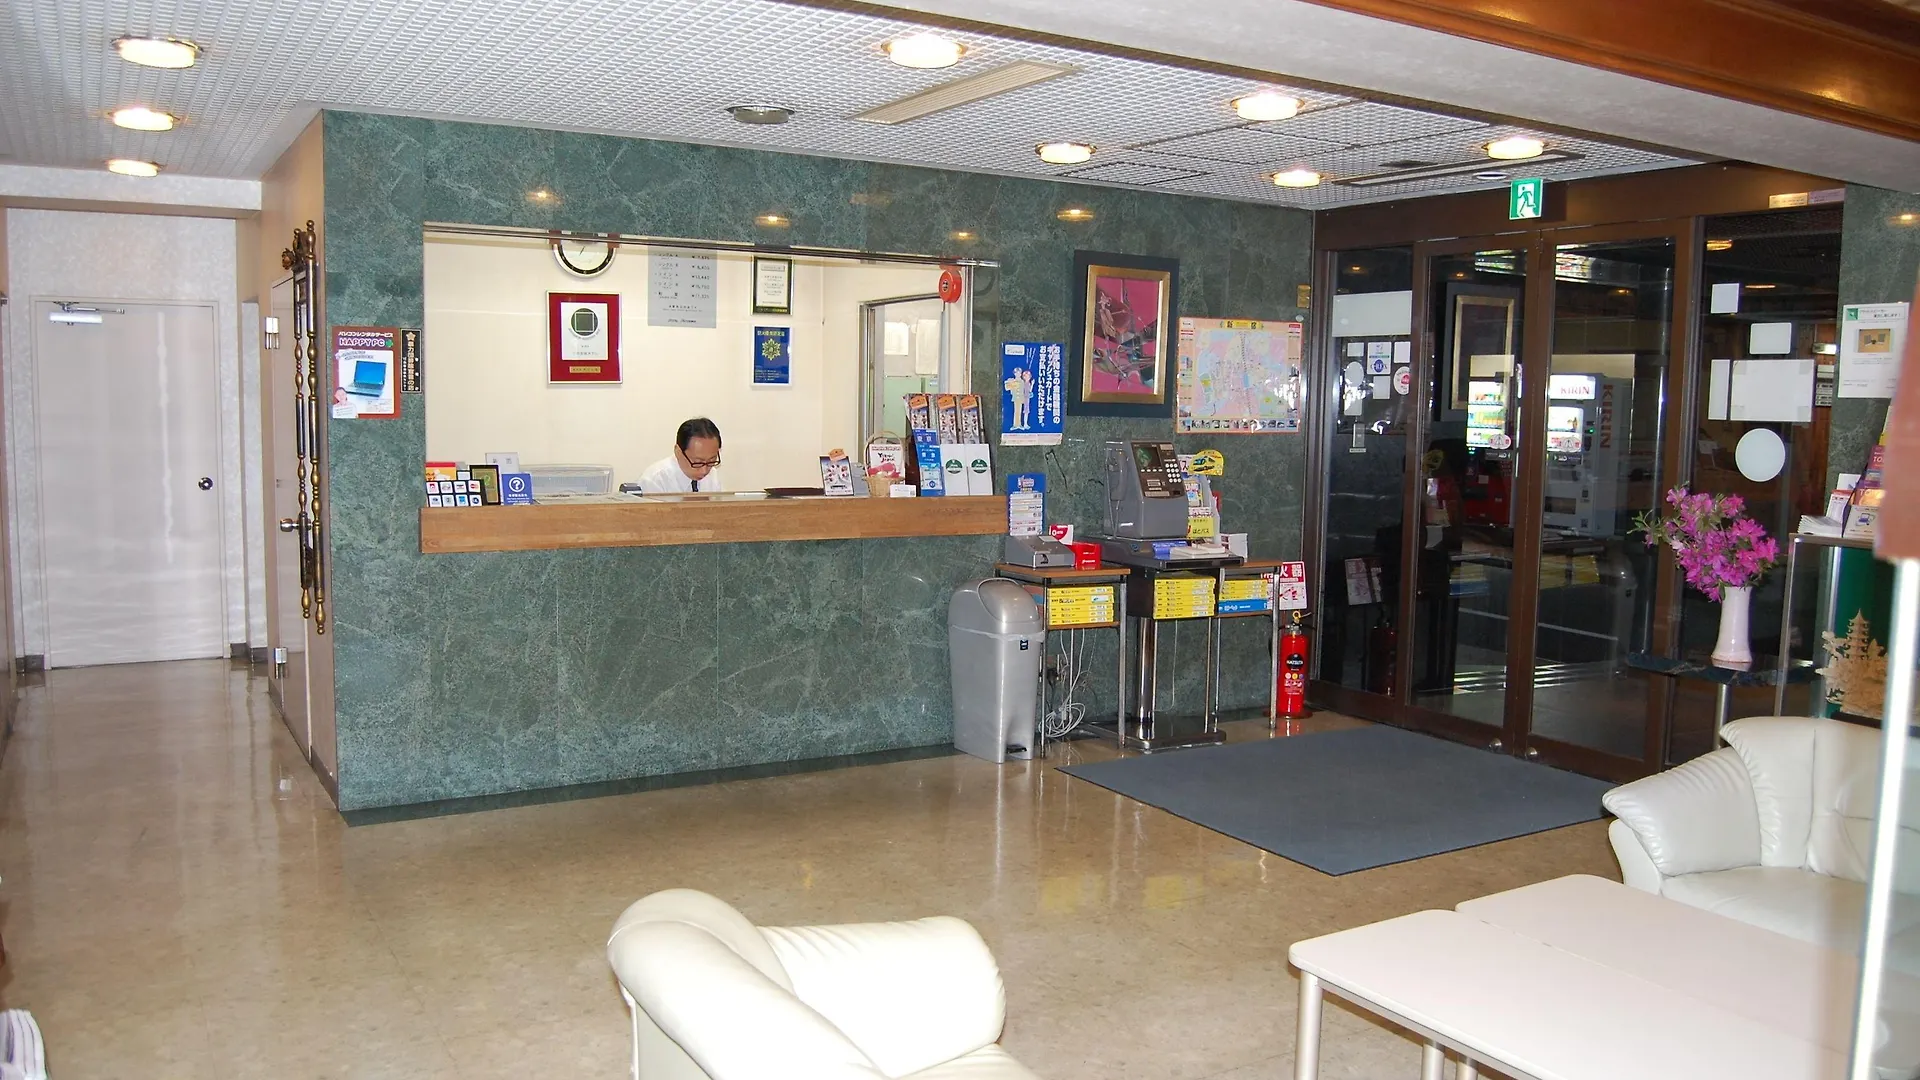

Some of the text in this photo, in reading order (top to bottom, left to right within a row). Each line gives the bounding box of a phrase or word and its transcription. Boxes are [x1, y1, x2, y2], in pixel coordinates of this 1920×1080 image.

[339, 338, 385, 347] HAPPY PC
[1561, 386, 1590, 395] KIRIN
[1601, 385, 1614, 448] KIRIN
